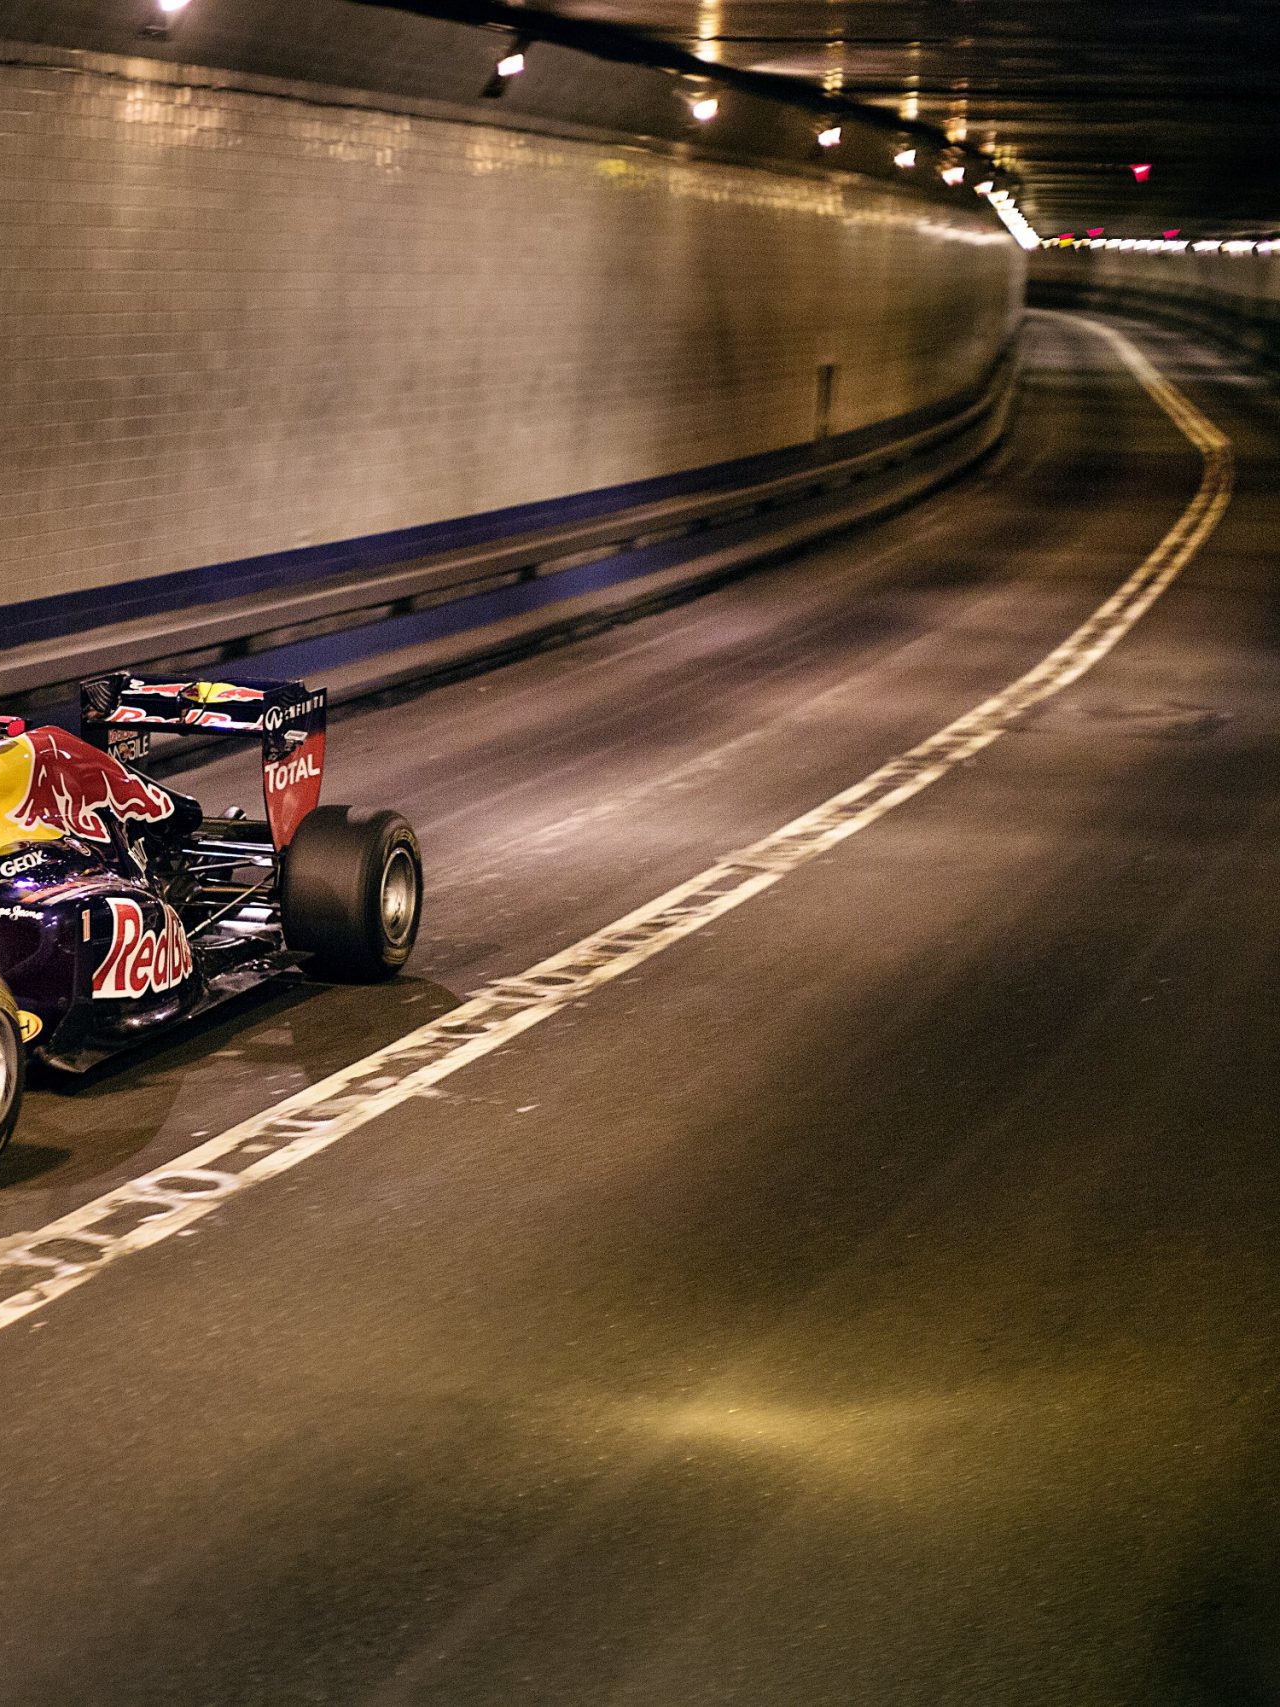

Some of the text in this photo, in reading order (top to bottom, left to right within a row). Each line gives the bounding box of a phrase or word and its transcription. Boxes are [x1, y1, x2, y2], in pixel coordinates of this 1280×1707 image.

[264, 753, 321, 794] TOTAL
[0, 850, 47, 877] GEOX
[92, 898, 170, 997] Red
